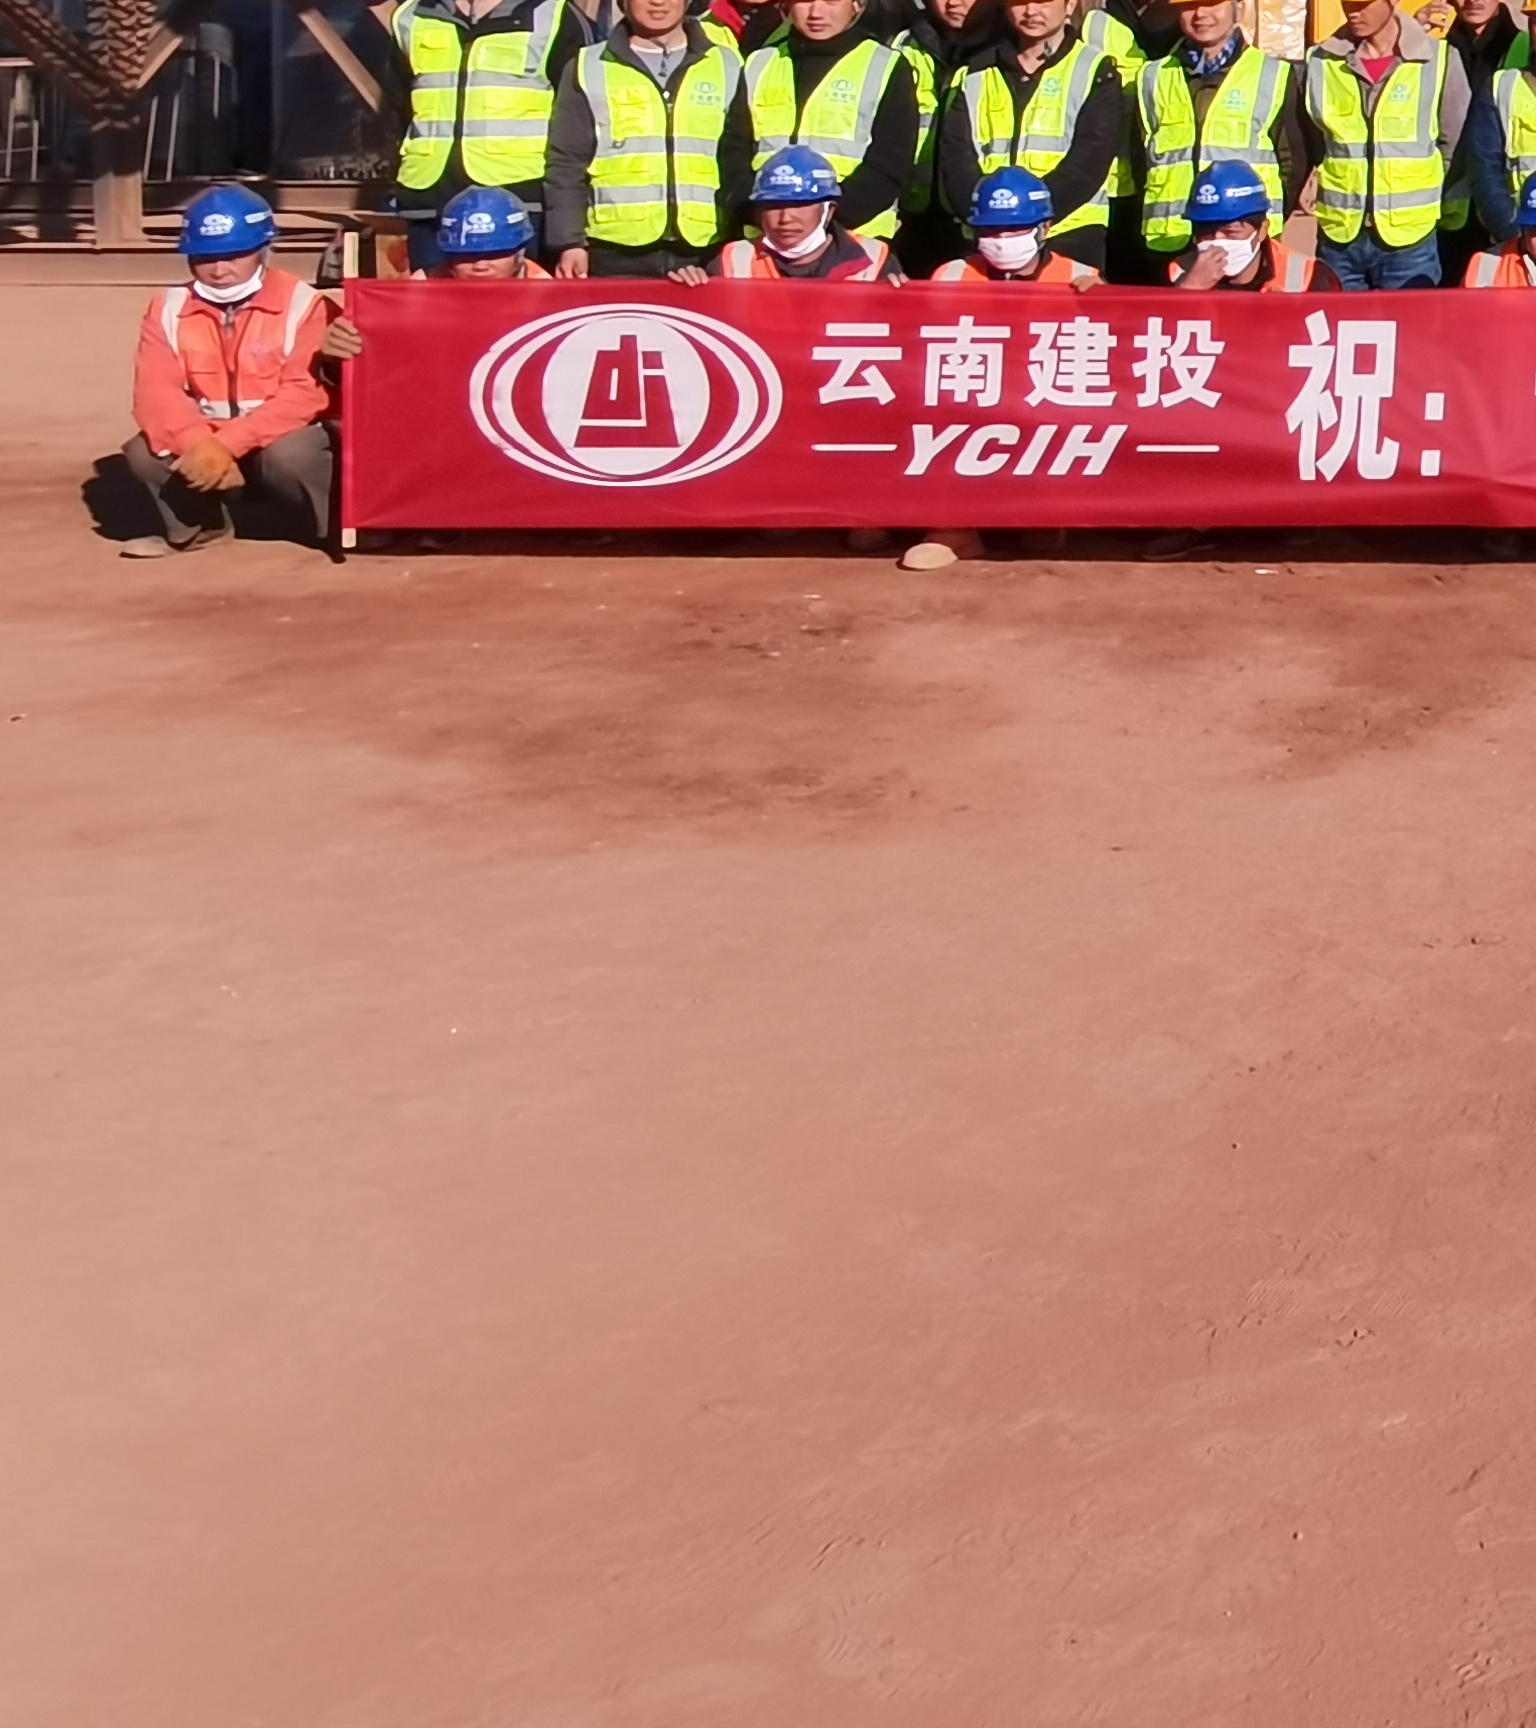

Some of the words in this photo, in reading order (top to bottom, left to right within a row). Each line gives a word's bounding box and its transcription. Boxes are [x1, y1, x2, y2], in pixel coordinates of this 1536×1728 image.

[811, 315, 1226, 408] 云南建投
[904, 424, 1128, 477] YCIH
